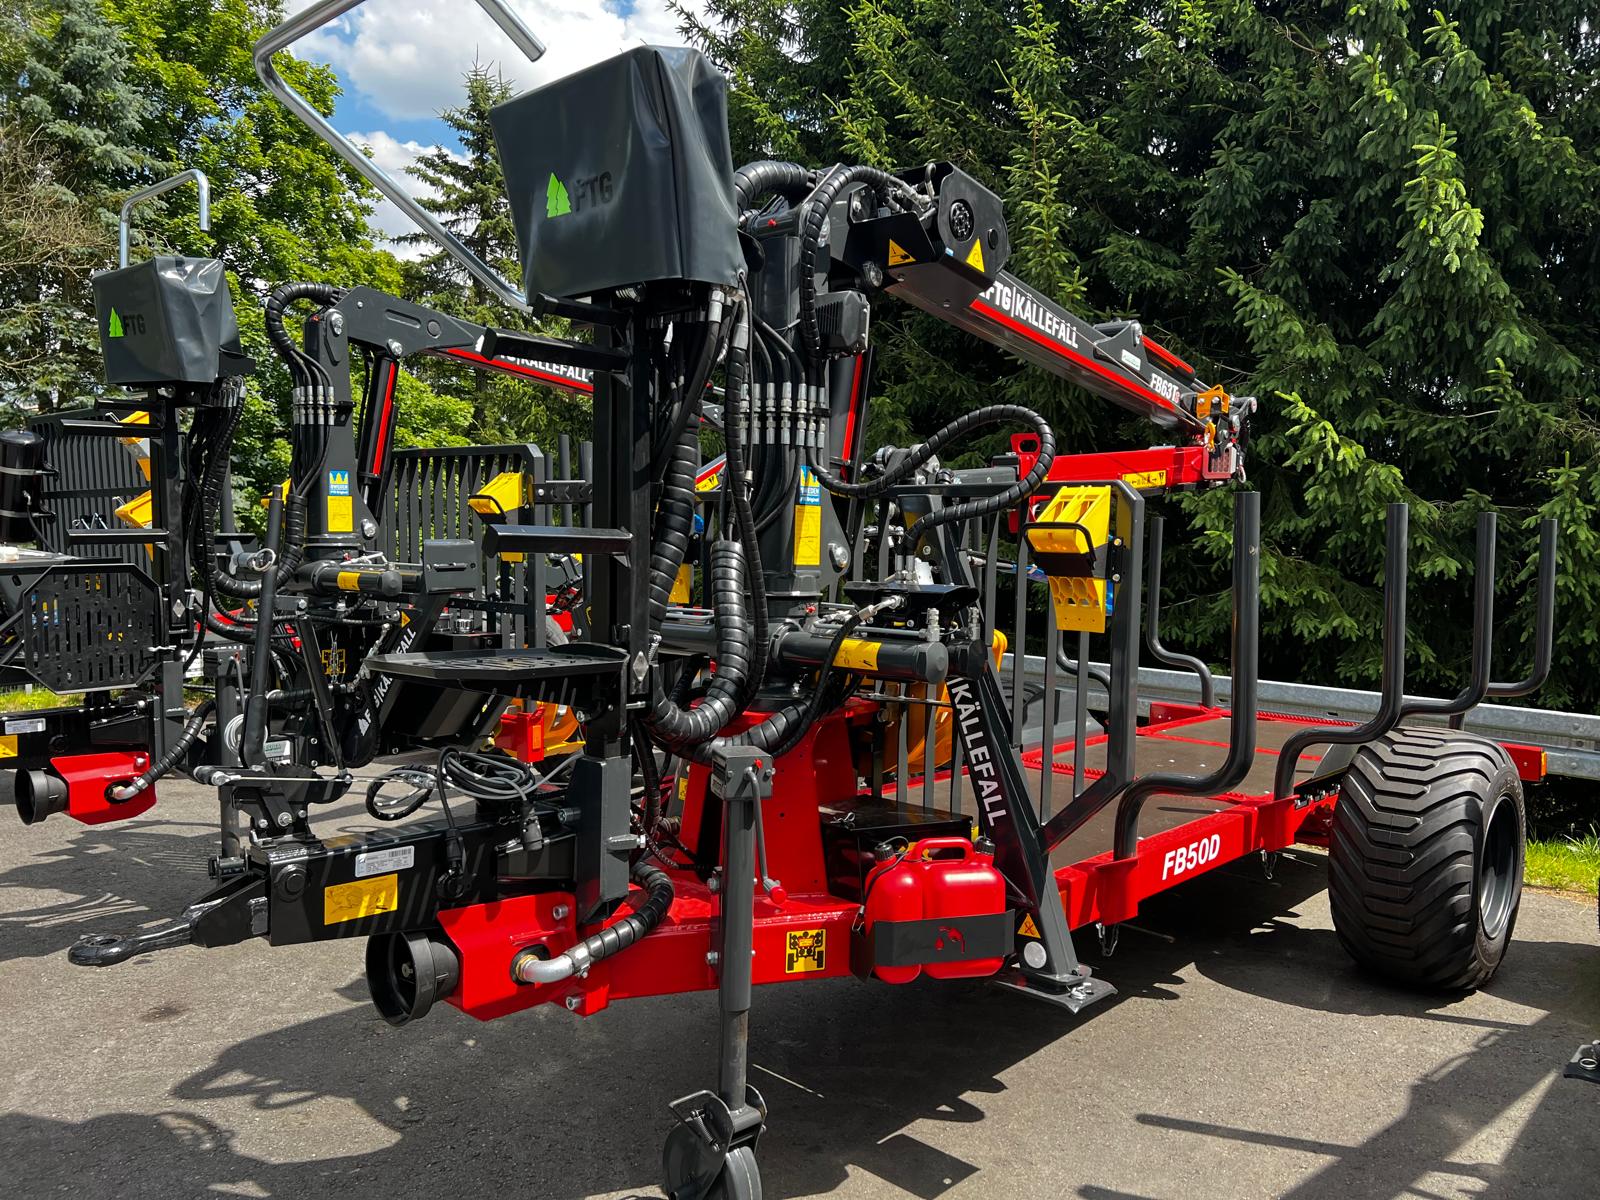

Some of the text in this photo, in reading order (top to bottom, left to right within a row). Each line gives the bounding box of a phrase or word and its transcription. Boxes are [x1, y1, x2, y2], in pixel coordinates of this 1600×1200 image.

[575, 170, 613, 212] FTG
[123, 314, 146, 336] FTG
[951, 683, 1007, 827] KÄLLEFALL
[1162, 833, 1221, 881] FB50D
